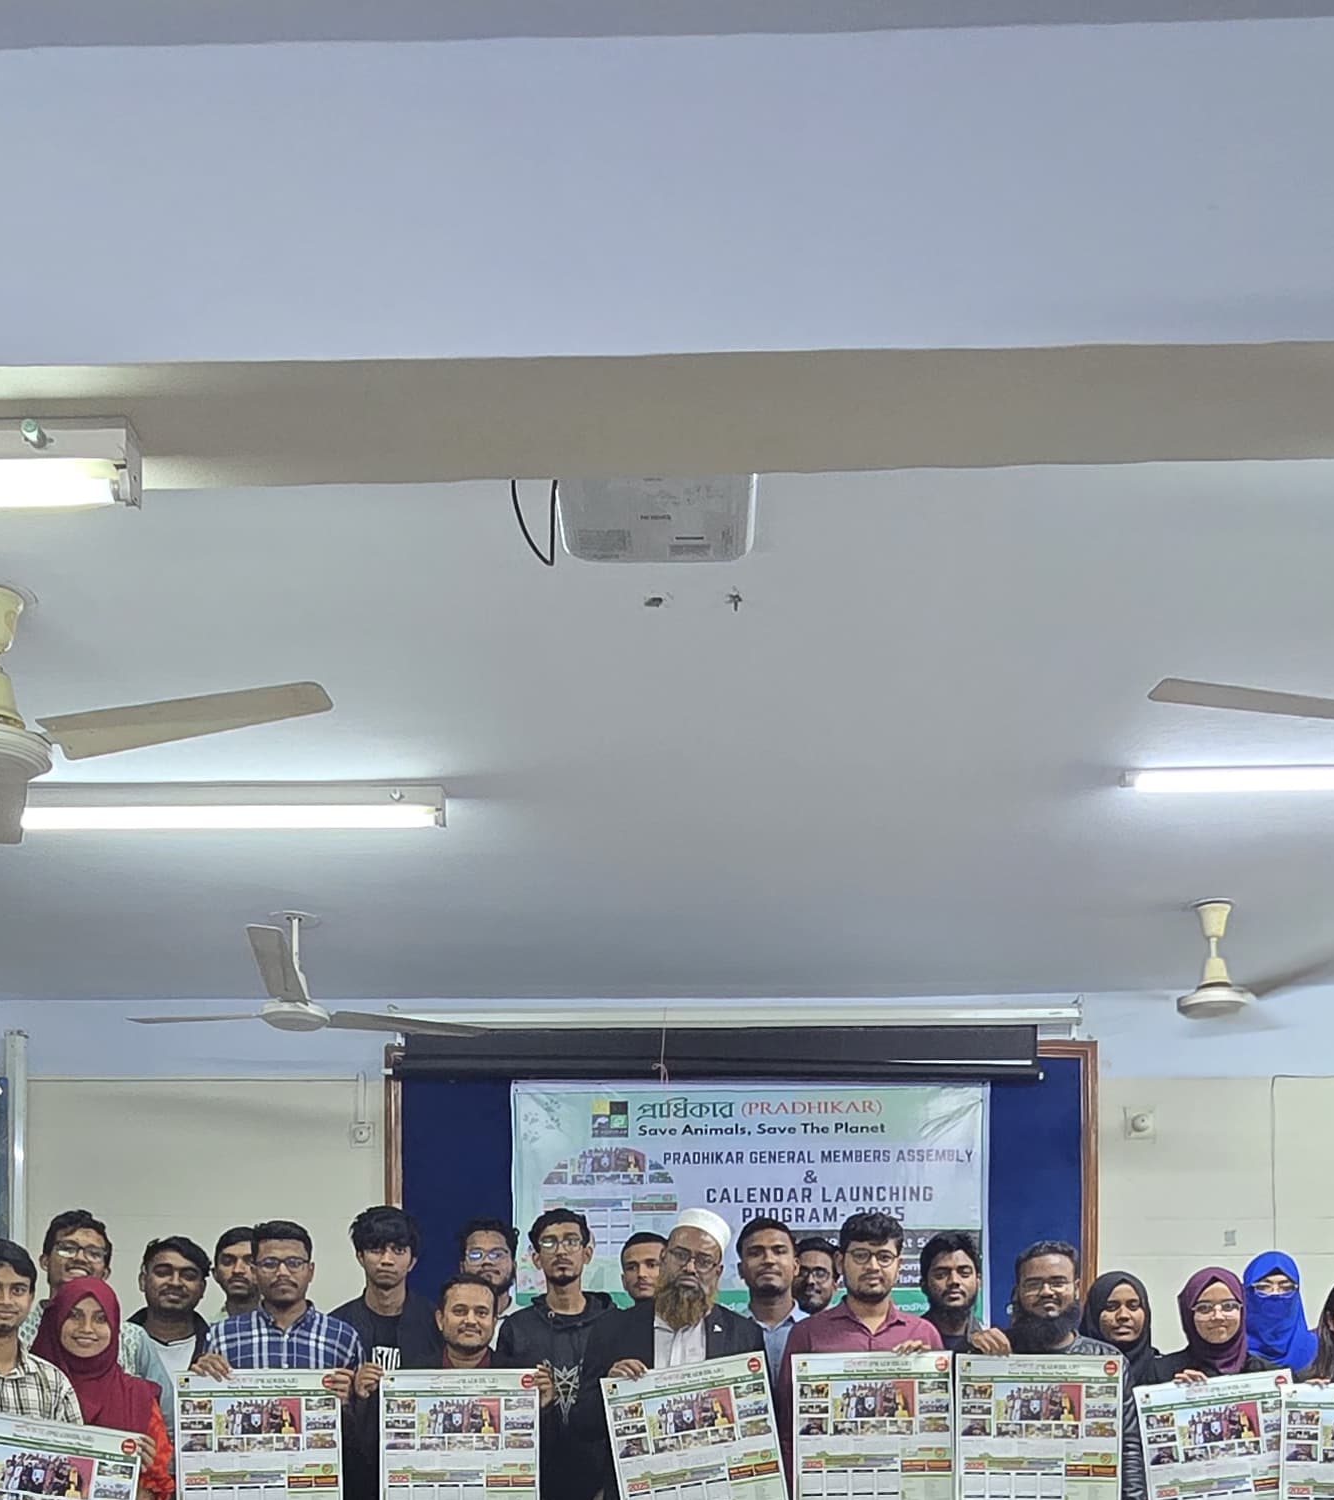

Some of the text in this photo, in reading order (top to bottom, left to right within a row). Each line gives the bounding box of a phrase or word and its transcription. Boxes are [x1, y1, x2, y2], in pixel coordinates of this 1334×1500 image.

[635, 1097, 883, 1122] প্রাধিকার (PRADHIKAR)
[638, 1125, 677, 1137] Save
[681, 1123, 751, 1137] Animals,
[756, 1122, 796, 1135] Save
[801, 1122, 829, 1134] The
[834, 1121, 885, 1134] Planet
[663, 1149, 973, 1165] PRADHIKAR GENERAL MEMBERS ASSEMBLY
[803, 1169, 818, 1184] &
[706, 1185, 934, 1204] CALENDAR LAUNCHING
